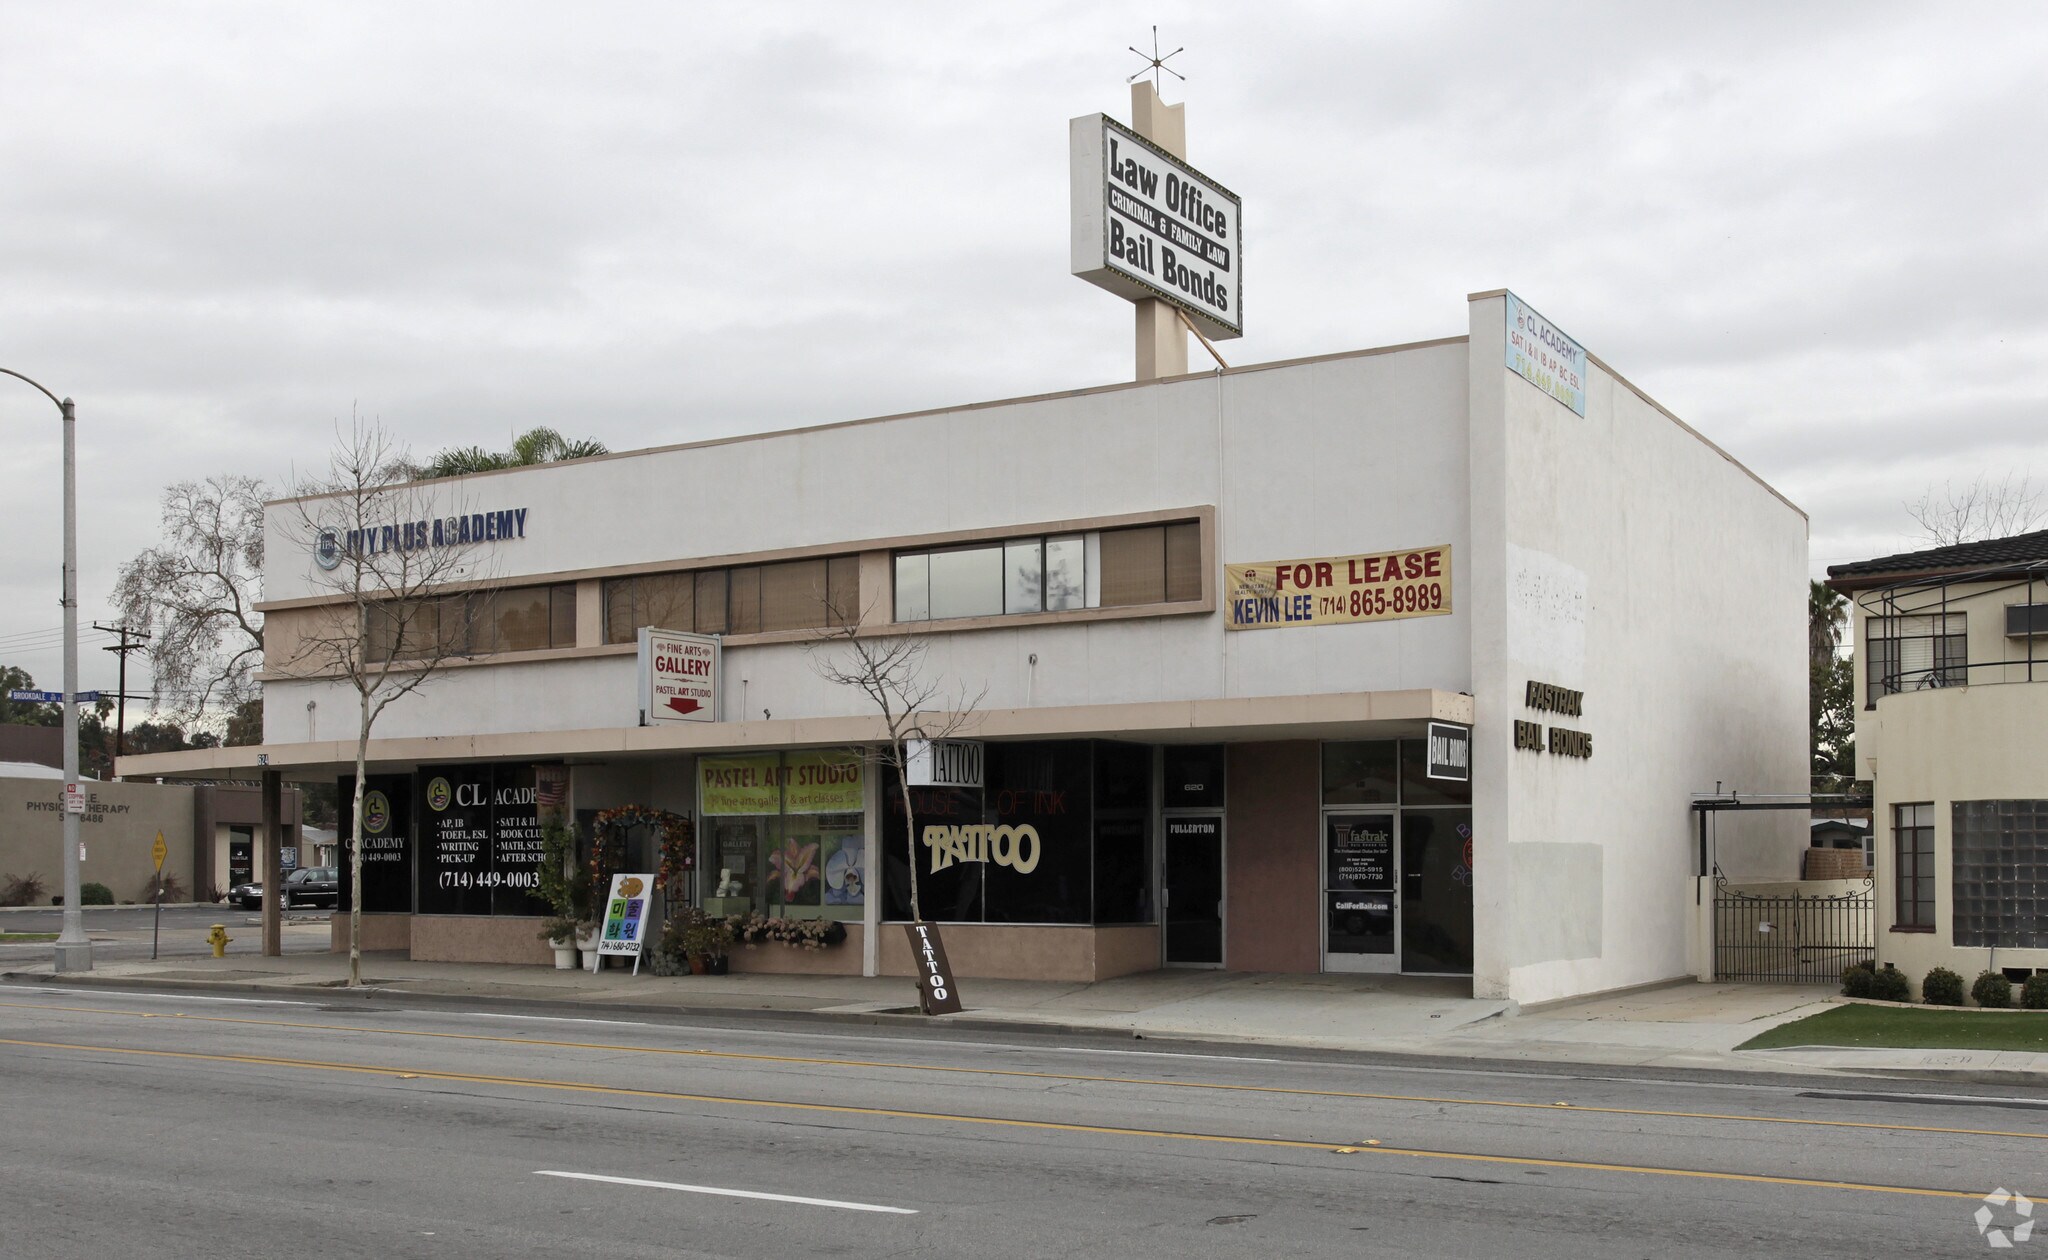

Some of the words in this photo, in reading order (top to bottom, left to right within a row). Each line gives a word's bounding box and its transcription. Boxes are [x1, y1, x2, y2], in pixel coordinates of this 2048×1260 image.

[1110, 137, 1158, 200] Law
[1165, 172, 1227, 239] Office
[1111, 188, 1155, 228] CRIMINAL
[1160, 217, 1167, 234] &
[1171, 224, 1203, 254] FAMILY
[1206, 243, 1227, 266] LAW
[1110, 216, 1155, 276] Bail
[1161, 245, 1228, 312] Bonds
[1527, 314, 1538, 337] CL
[1539, 324, 1578, 364] ACADEMY
[1511, 330, 1523, 349] SAT
[1569, 372, 1580, 391] ESL
[346, 527, 379, 558] IVY
[381, 520, 428, 555] PLUS
[431, 507, 528, 548] ACADEMY
[1275, 562, 1334, 591] FOR
[1347, 551, 1442, 585] LEASE
[1233, 596, 1280, 624] KEVIN
[1284, 594, 1313, 622] LEE
[1319, 595, 1346, 616] (714)
[1349, 582, 1442, 617] 865-8989
[666, 643, 683, 655] FINE
[684, 645, 702, 657] ARTS
[655, 655, 711, 677] GALLERY
[13, 691, 46, 701] BROOKDALE
[656, 685, 677, 696] PASTEL
[677, 687, 690, 696] ART
[690, 688, 712, 698] STUDIO
[1525, 680, 1584, 717] FASTRAK
[1514, 719, 1545, 752] BAIL
[1549, 727, 1592, 759] BONDS
[1431, 735, 1449, 766] BAIL
[1449, 738, 1467, 768] BONDS
[257, 754, 269, 766] 624
[931, 741, 980, 784] TATTOO
[704, 767, 759, 788] PASTEL
[798, 763, 859, 786] STUDIO
[68, 784, 75, 792] NO
[1183, 783, 1204, 791] 620
[456, 783, 487, 807] CL
[494, 787, 537, 805] ACADE
[739, 795, 757, 806] arts
[790, 794, 797, 804] &
[799, 794, 812, 805] art
[814, 792, 844, 804] classes
[997, 789, 1027, 816] OF
[1034, 789, 1067, 815] INK
[454, 818, 464, 828] IB
[500, 817, 514, 827] SAT
[516, 817, 520, 827] I
[521, 817, 528, 826] &
[1170, 823, 1215, 834] FULLERTON
[440, 830, 471, 840] TOEFL,
[472, 830, 488, 839] ESL
[500, 829, 524, 839] BOOK
[525, 829, 543, 838] CLU
[1350, 829, 1387, 842] fastrak
[360, 837, 405, 849] ACADEMY
[440, 841, 479, 852] WRITING
[500, 841, 526, 852] MATH,
[722, 840, 752, 848] GALLERY
[922, 823, 1041, 875] TATTOO
[368, 852, 402, 862] 449-0003
[440, 853, 476, 863] PICK-UP
[500, 853, 527, 863] AFTER
[439, 871, 474, 890] (714)
[476, 871, 540, 888] 449-0003
[1338, 873, 1384, 881] (714)870-7730
[1335, 901, 1388, 911] CallForBail.com
[915, 925, 948, 1000] TATTOO
